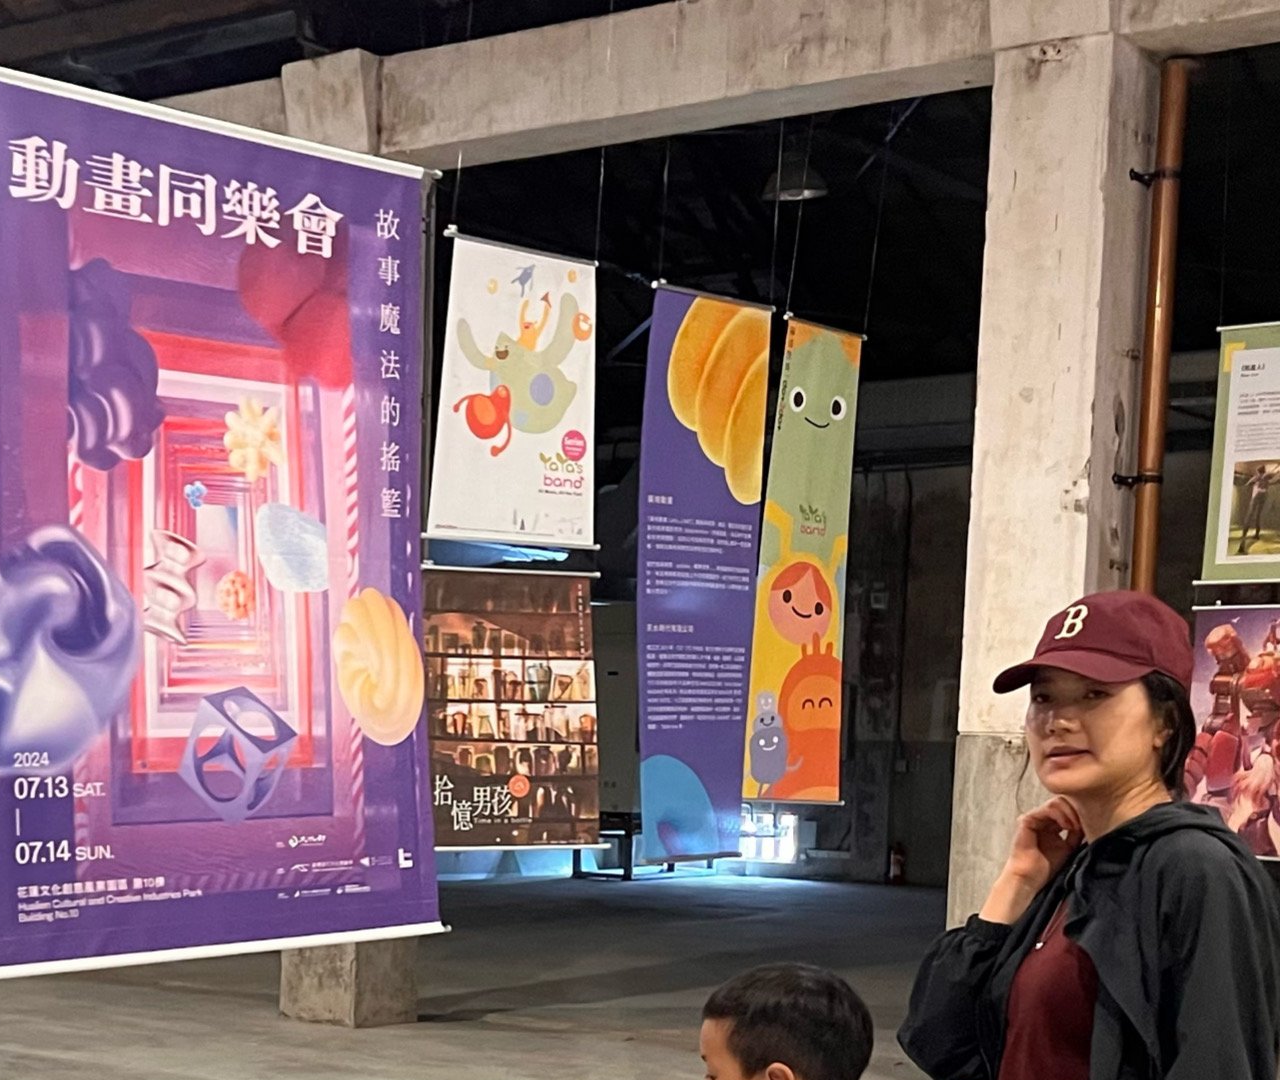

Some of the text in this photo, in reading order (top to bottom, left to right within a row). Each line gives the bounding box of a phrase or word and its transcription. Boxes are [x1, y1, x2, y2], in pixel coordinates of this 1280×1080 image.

[8, 135, 344, 259] 動畫同樂會
[374, 208, 402, 519] 故事魔法的搖籃
[1054, 604, 1089, 640] B
[13, 751, 50, 768] 2024
[13, 775, 106, 800] 07.13 SAT.
[14, 839, 115, 865] 07.14 SUN.
